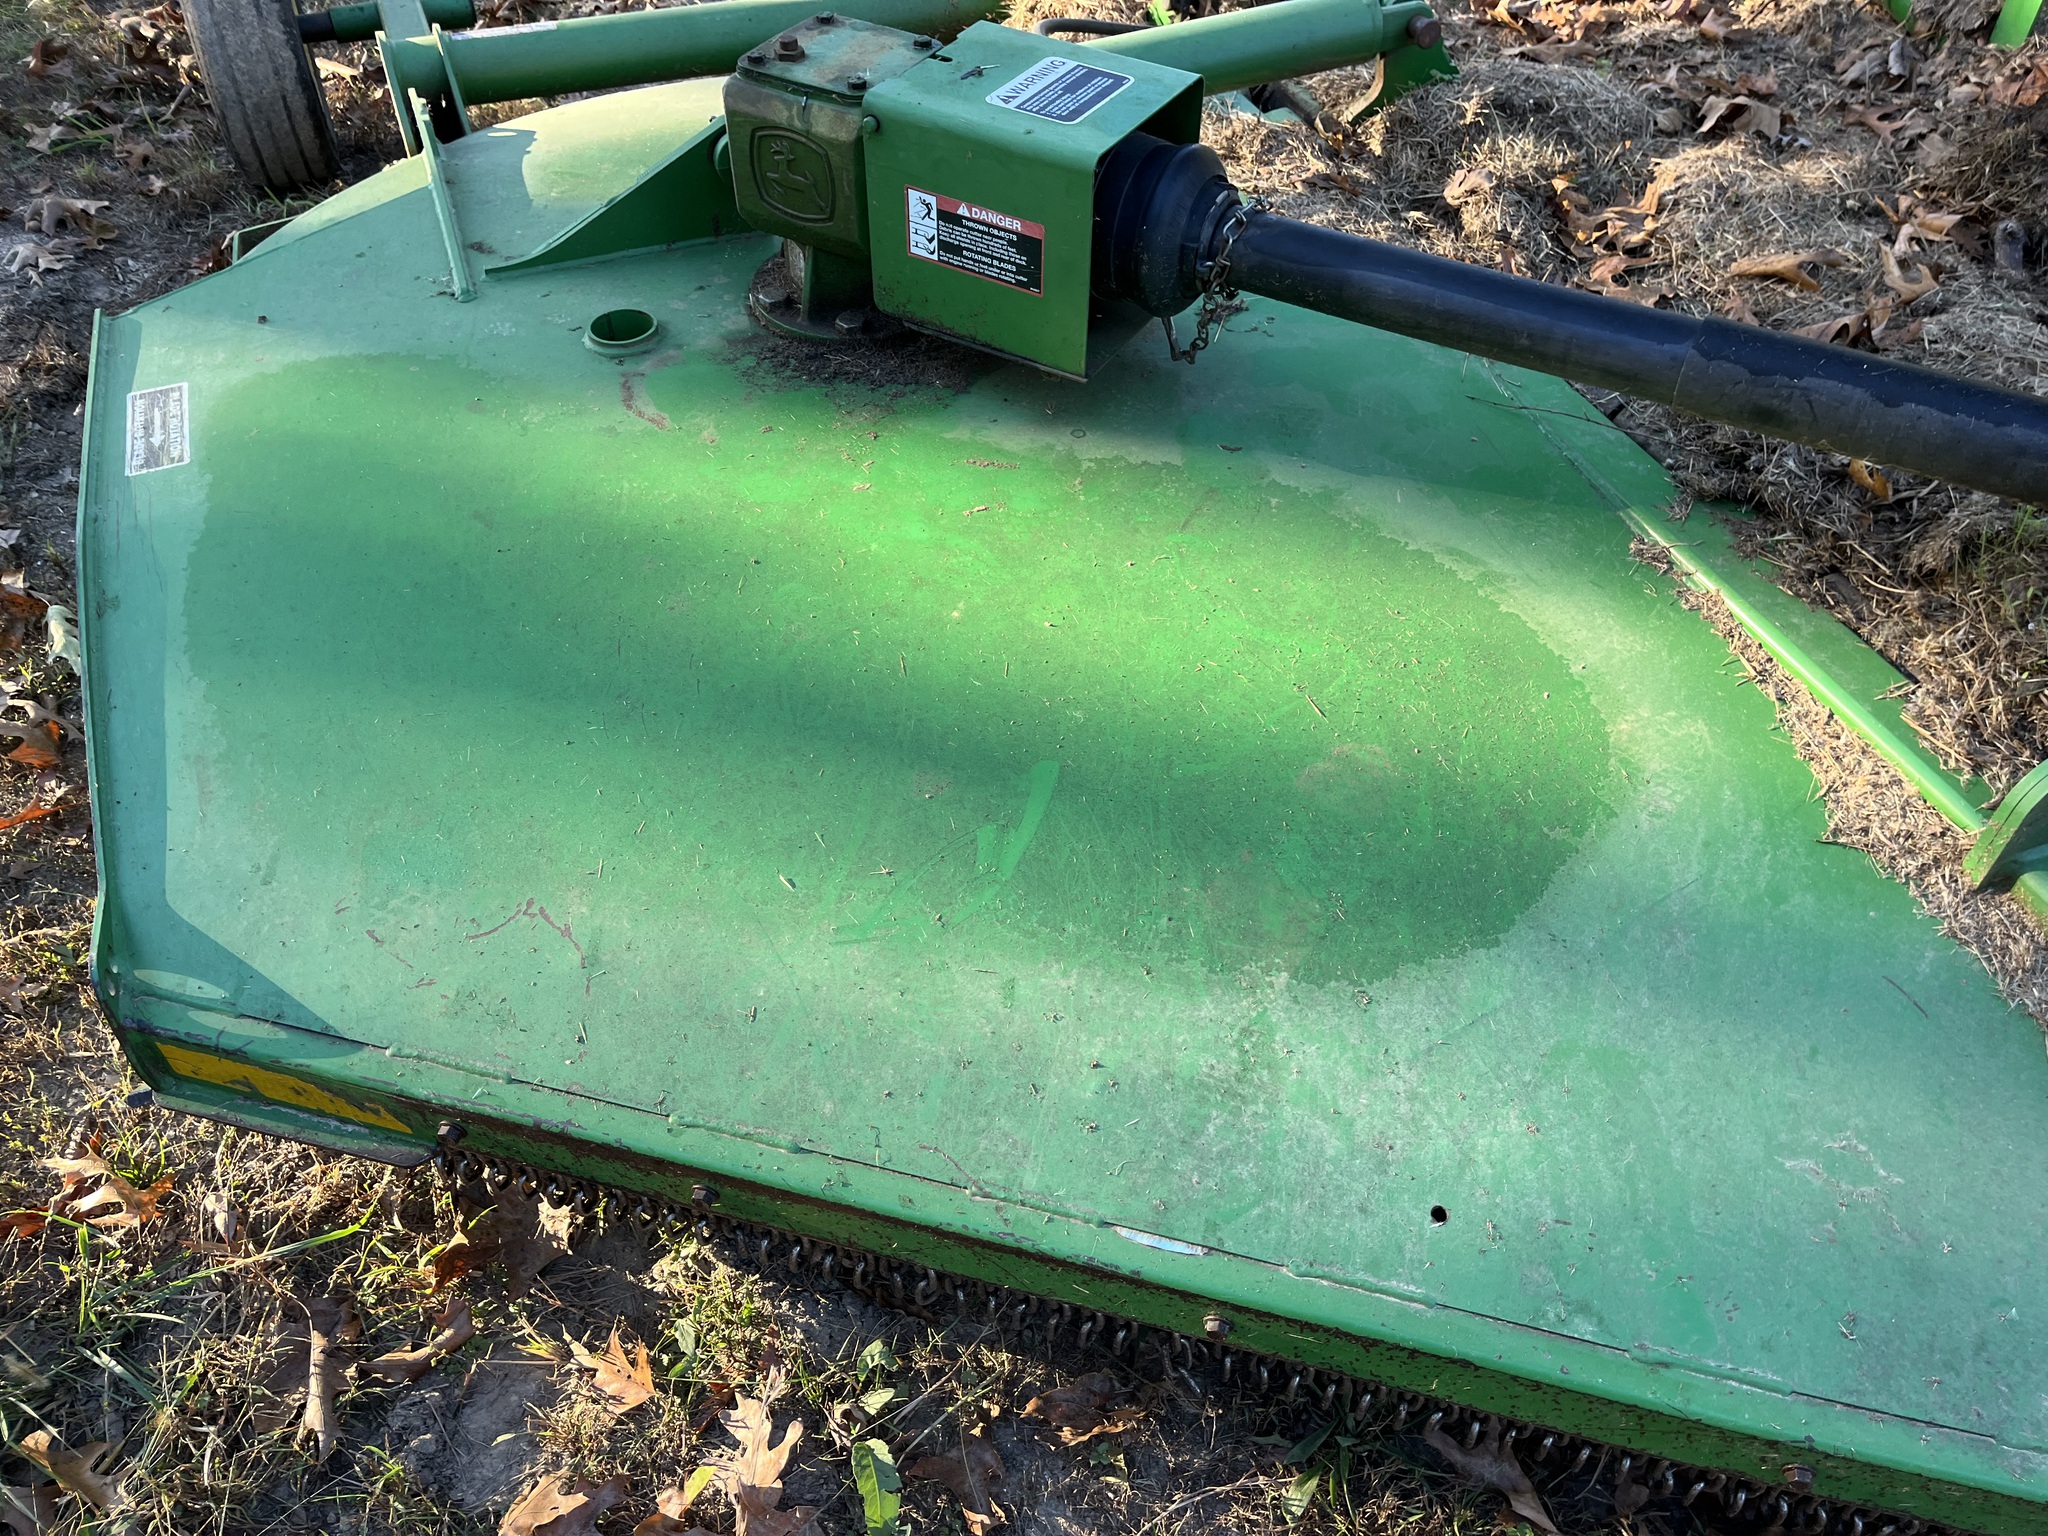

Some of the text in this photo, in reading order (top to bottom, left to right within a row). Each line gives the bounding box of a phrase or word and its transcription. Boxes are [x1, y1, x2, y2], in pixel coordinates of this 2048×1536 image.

[1010, 59, 1067, 98] WARNING
[962, 219, 1017, 242] THROWN OBJECTS
[971, 207, 1022, 231] DANGER
[963, 250, 1017, 272] ROTATING BLADES
[170, 392, 181, 458] BLADE ROTATION
